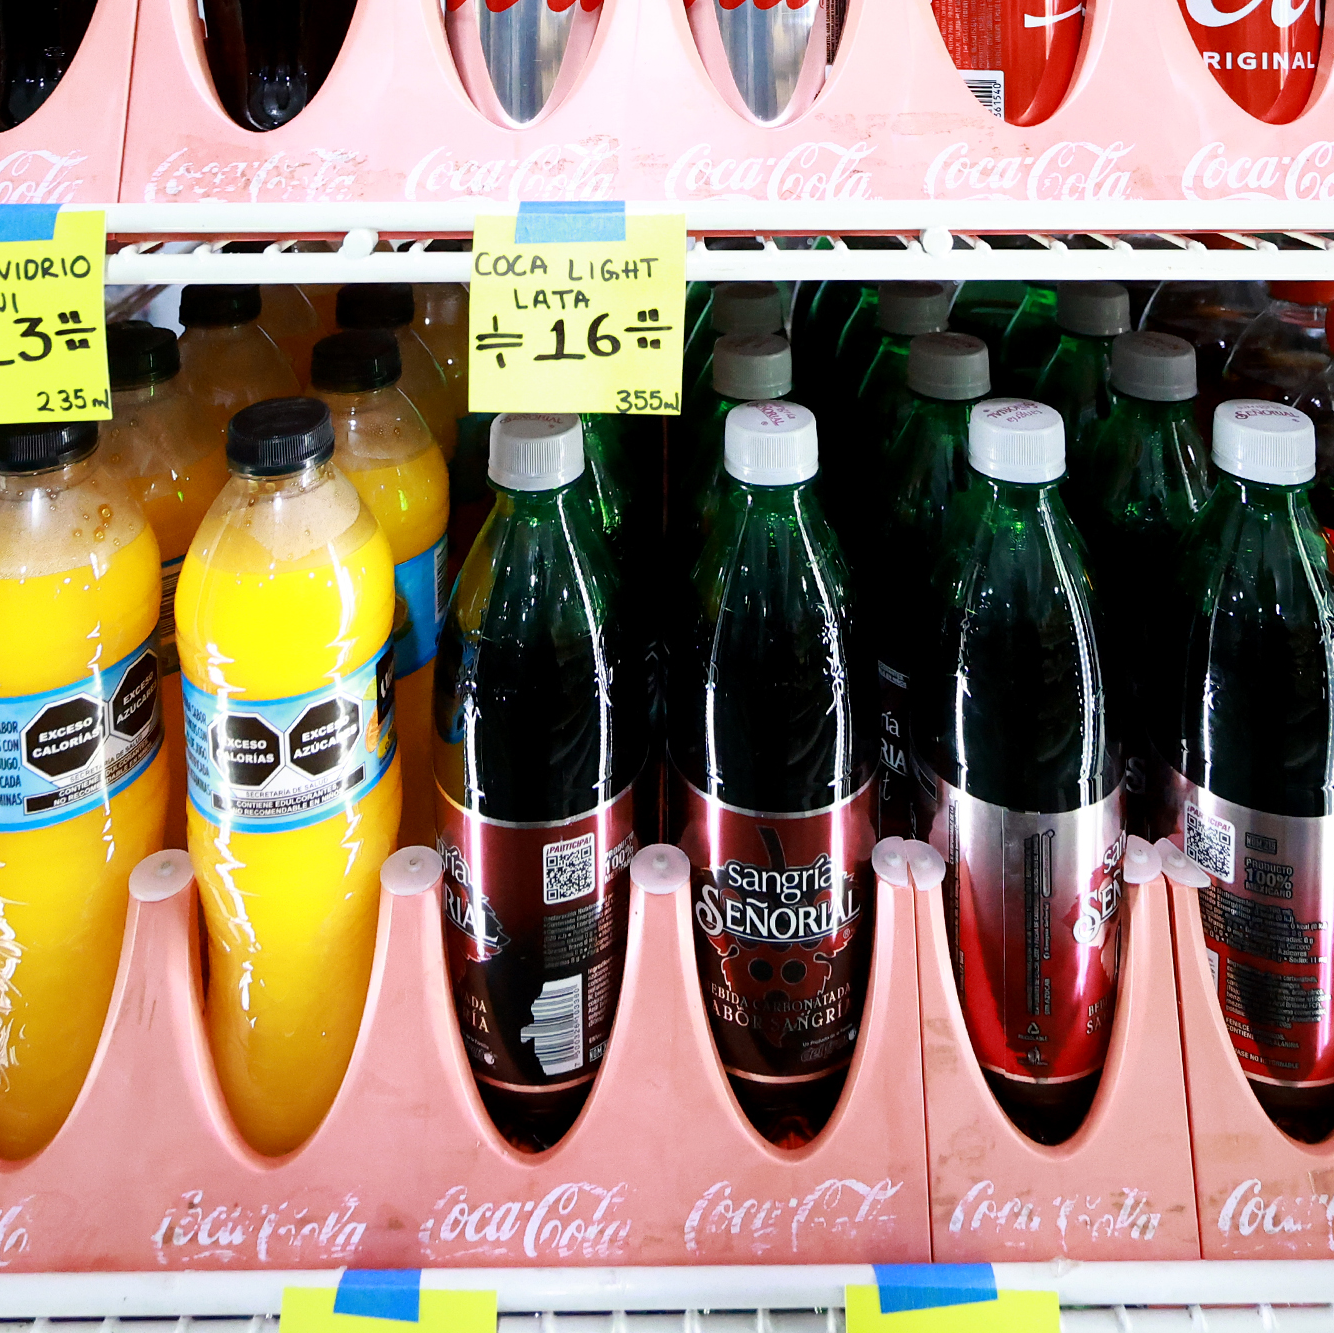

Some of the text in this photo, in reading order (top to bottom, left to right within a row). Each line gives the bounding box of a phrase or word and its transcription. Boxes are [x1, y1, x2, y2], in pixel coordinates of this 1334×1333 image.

[1203, 52, 1315, 70] RIGINAL
[405, 142, 623, 201] Coca-Cola
[664, 141, 879, 201] Coca-Cola
[923, 140, 1136, 201] Coca-Cola
[474, 251, 659, 282] COCA LIGHT
[513, 288, 591, 310] LATA
[123, 670, 154, 706] EXCESO
[32, 724, 101, 758] CALORÍAS
[39, 716, 93, 743] EXCESO
[293, 723, 358, 760] AZÚCARES
[302, 715, 350, 743] EXCESO
[3, 739, 20, 750] CON
[124, 733, 145, 753] SALUD
[58, 775, 101, 798] CONTIENE
[245, 777, 329, 798] SECRETARÍA DE SALUD
[53, 797, 66, 806] NO
[236, 800, 274, 808] CONTIENE
[244, 801, 309, 816] RECOMENDABLE
[1187, 805, 1231, 833] ¡PARICIPA!
[728, 857, 835, 905] sangría
[1246, 868, 1292, 890] 100%
[695, 883, 861, 940] SEÑORIAL
